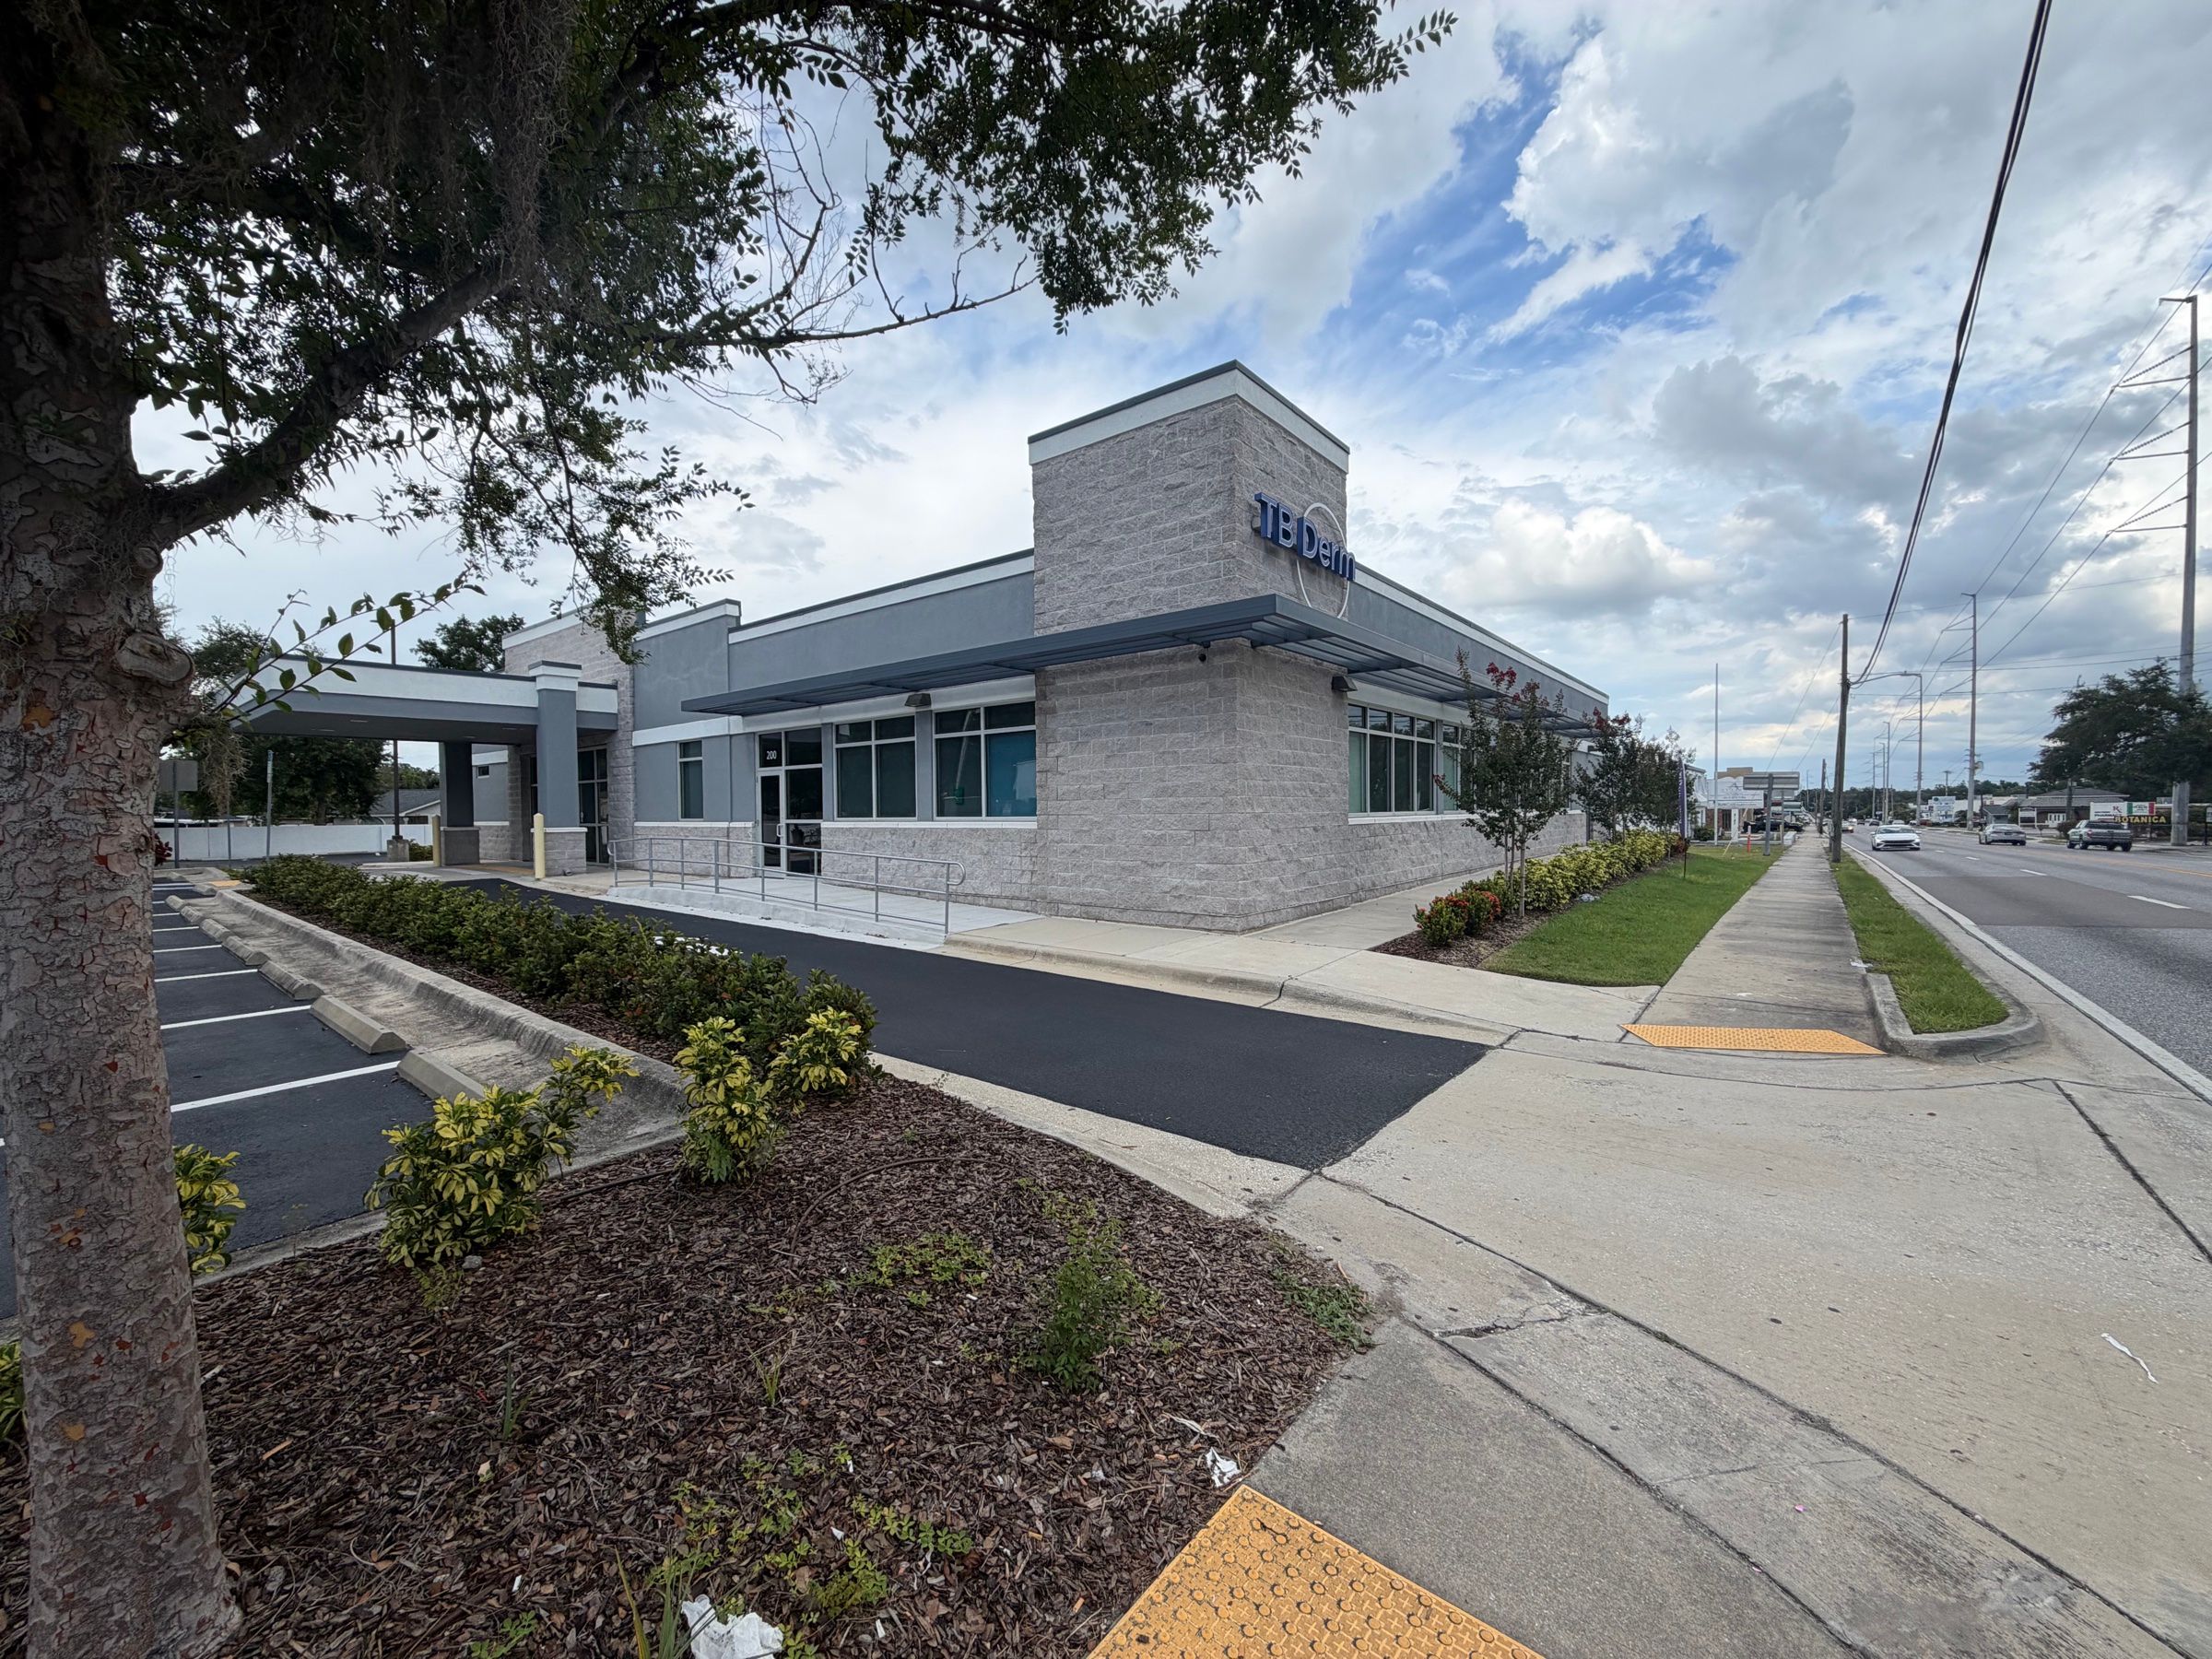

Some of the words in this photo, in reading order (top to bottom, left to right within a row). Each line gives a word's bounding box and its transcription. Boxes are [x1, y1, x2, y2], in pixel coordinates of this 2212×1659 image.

[1254, 492, 1294, 548] TB
[1297, 516, 1357, 582] Derm
[766, 750, 777, 760] 200
